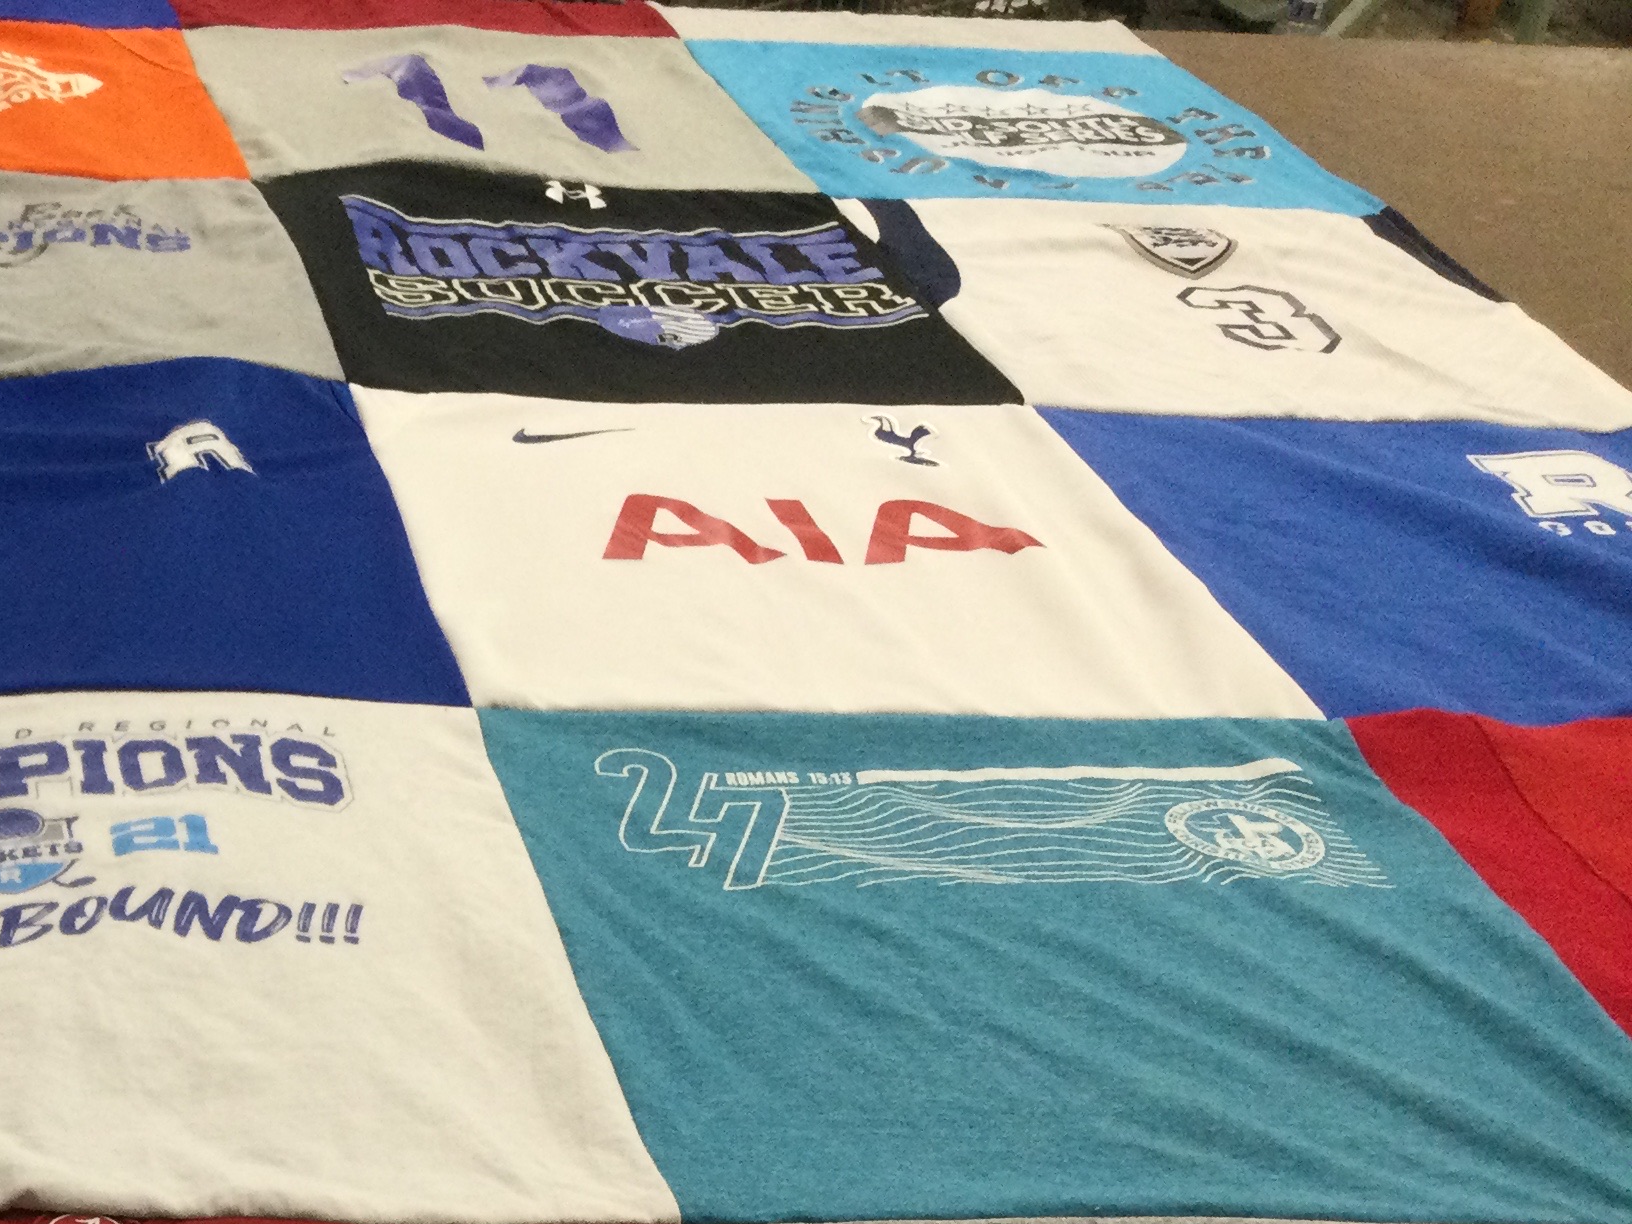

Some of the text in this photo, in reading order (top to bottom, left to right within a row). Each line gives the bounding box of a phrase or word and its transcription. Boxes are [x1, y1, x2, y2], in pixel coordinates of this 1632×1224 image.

[342, 210, 884, 285] ROCKVALE
[368, 268, 918, 318] SOCCER
[1176, 285, 1341, 354] 3
[602, 493, 1048, 566] AIA
[77, 717, 337, 738] REGIONAL
[724, 771, 801, 787] ROMANS
[110, 813, 219, 857] 21
